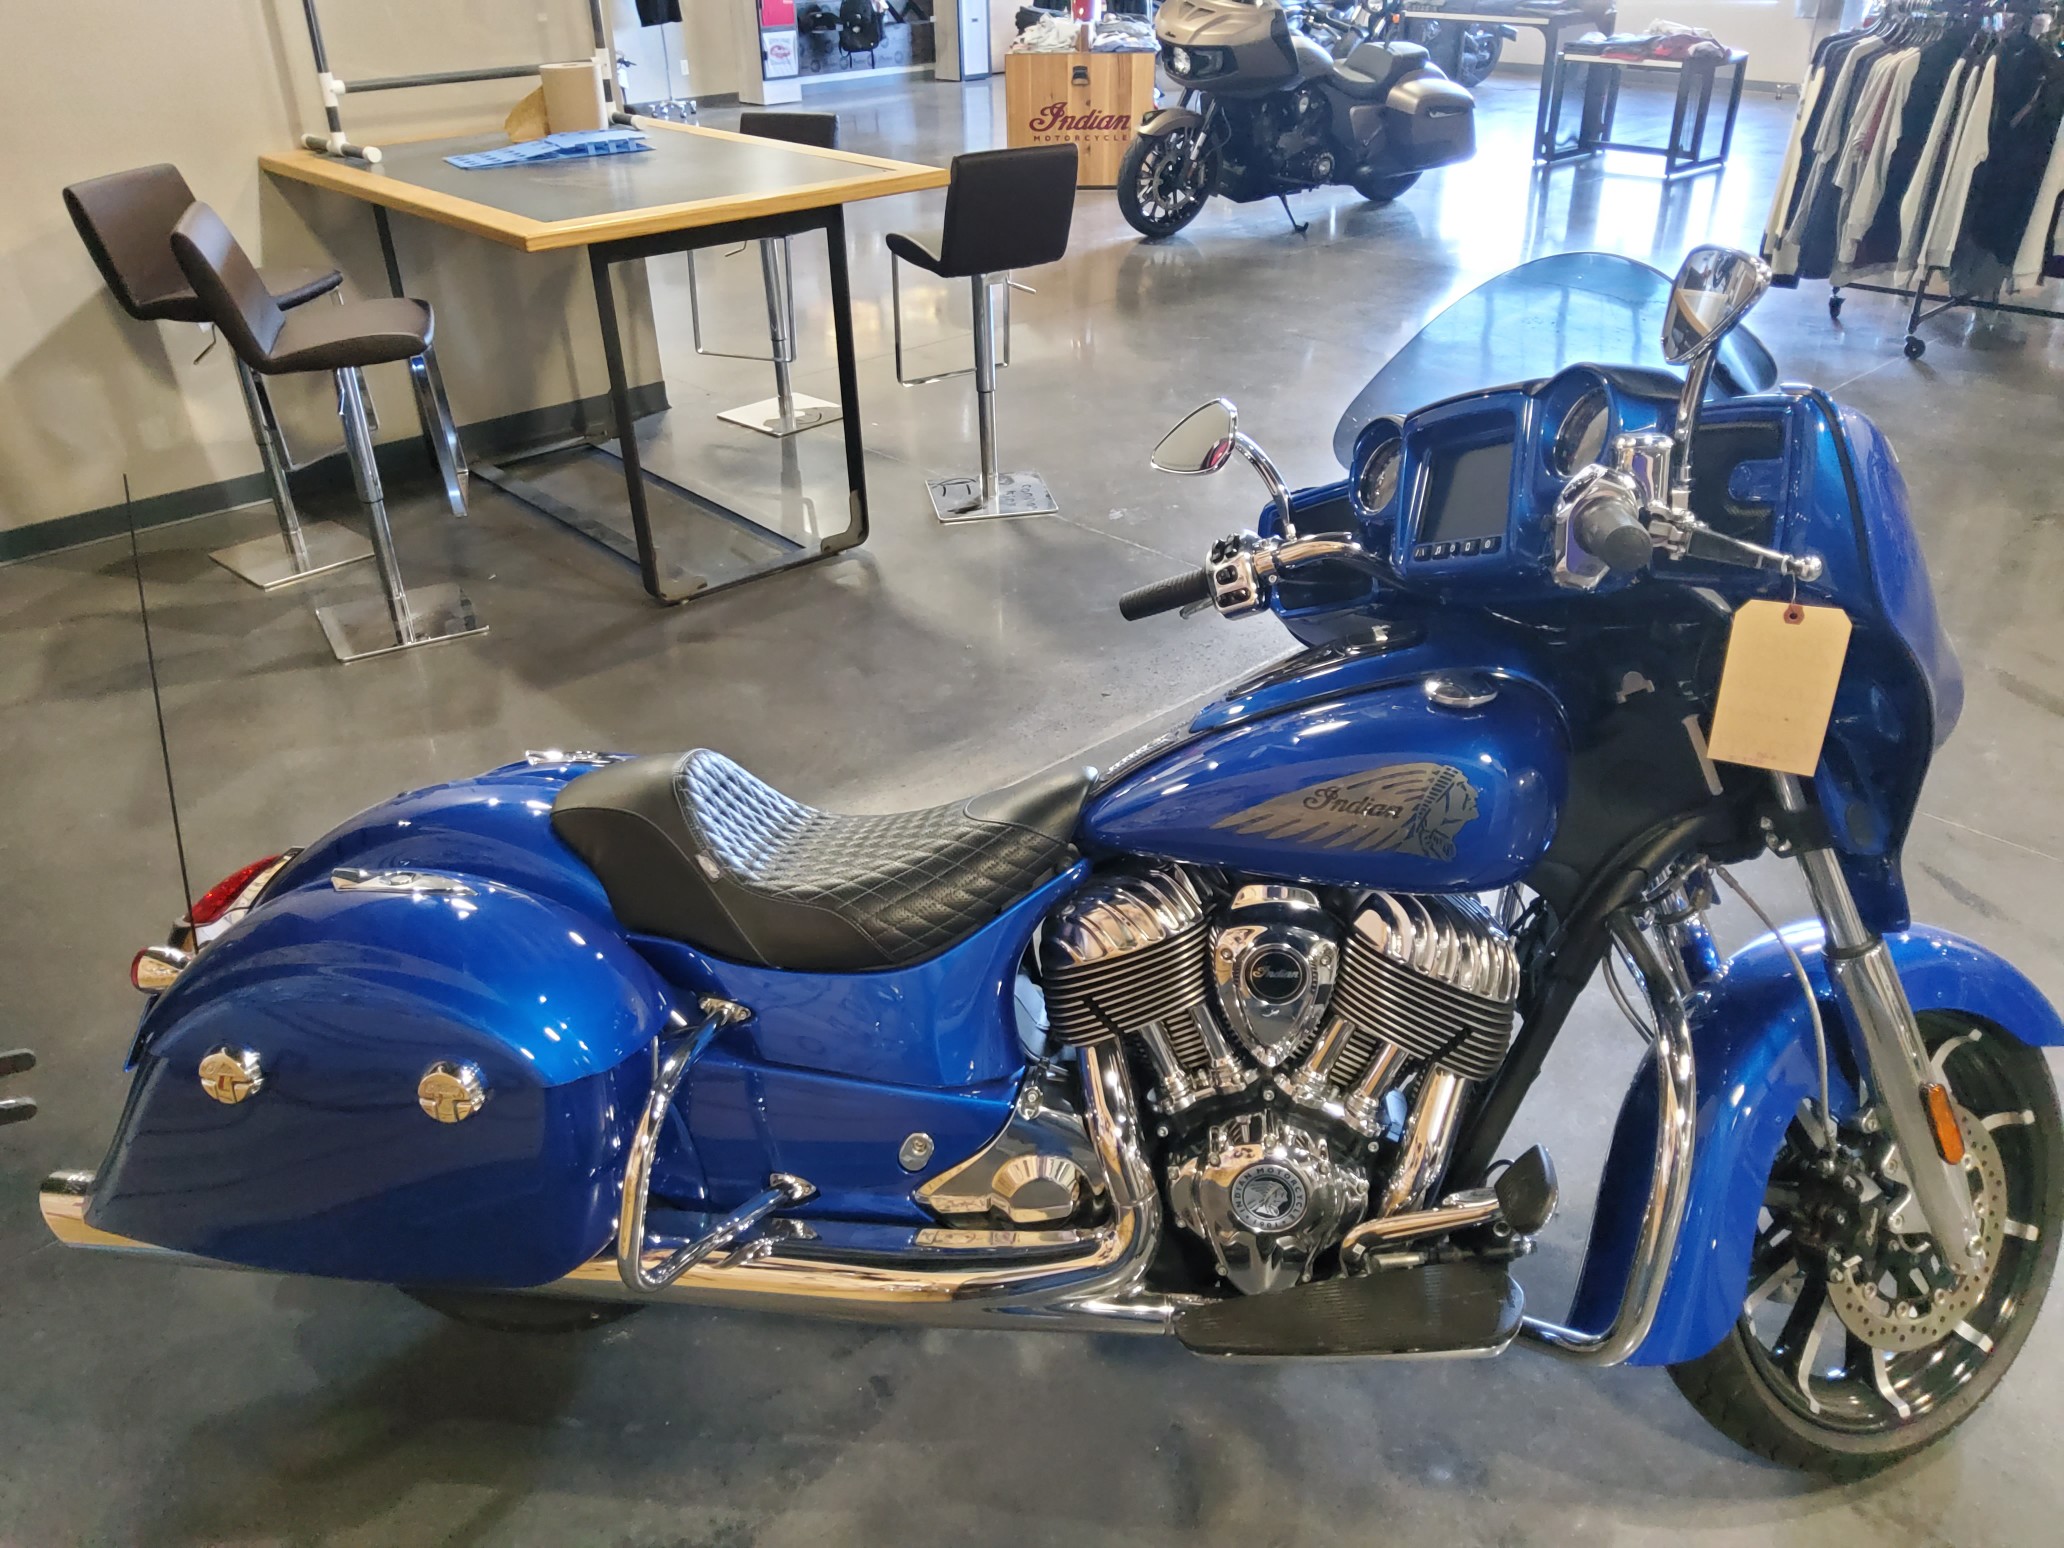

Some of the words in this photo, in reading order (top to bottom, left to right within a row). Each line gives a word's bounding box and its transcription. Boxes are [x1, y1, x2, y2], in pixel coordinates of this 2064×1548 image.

[1029, 102, 1131, 132] Indian
[1033, 134, 1129, 142] MOTORCYCLE
[1303, 784, 1403, 820] Indian
[1234, 1172, 1252, 1213] INDIAN
[1256, 1167, 1303, 1220] MOTORCYCLE
[1253, 1219, 1278, 1228] 1901
